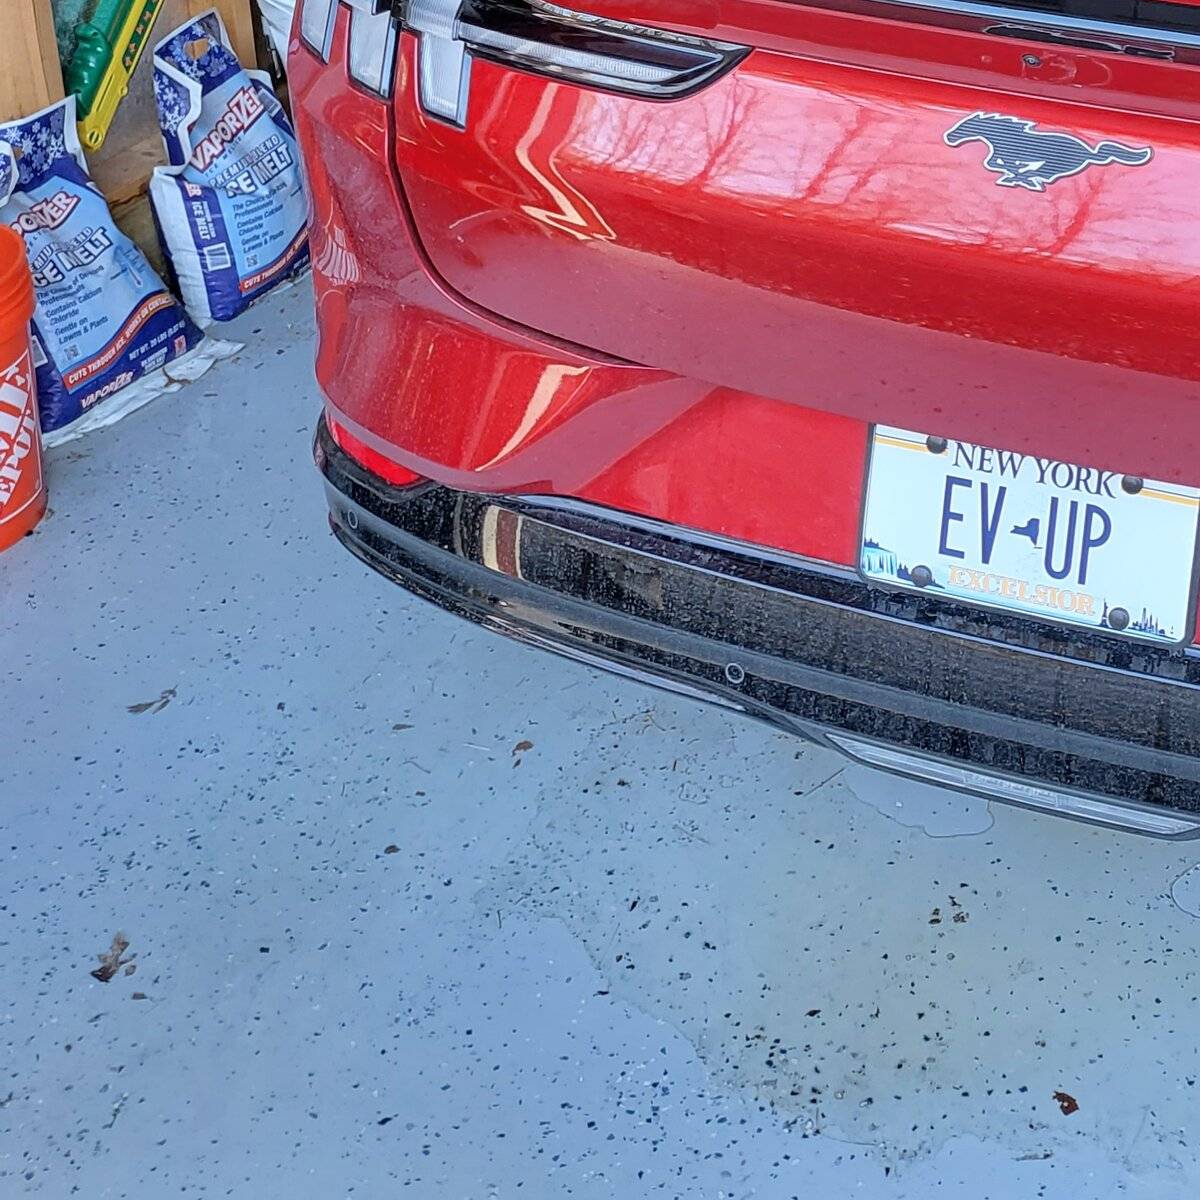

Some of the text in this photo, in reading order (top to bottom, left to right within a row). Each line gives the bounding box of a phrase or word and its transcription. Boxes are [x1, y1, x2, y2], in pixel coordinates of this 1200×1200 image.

[251, 142, 293, 185] MELT
[32, 259, 66, 288] CE
[56, 226, 114, 272] MELT
[69, 367, 88, 384] CUTS
[0, 406, 36, 506] EPOT
[952, 441, 1118, 500] NEW YORK
[938, 474, 1112, 586] EV UP
[947, 564, 1096, 617] EXCELSIOR
